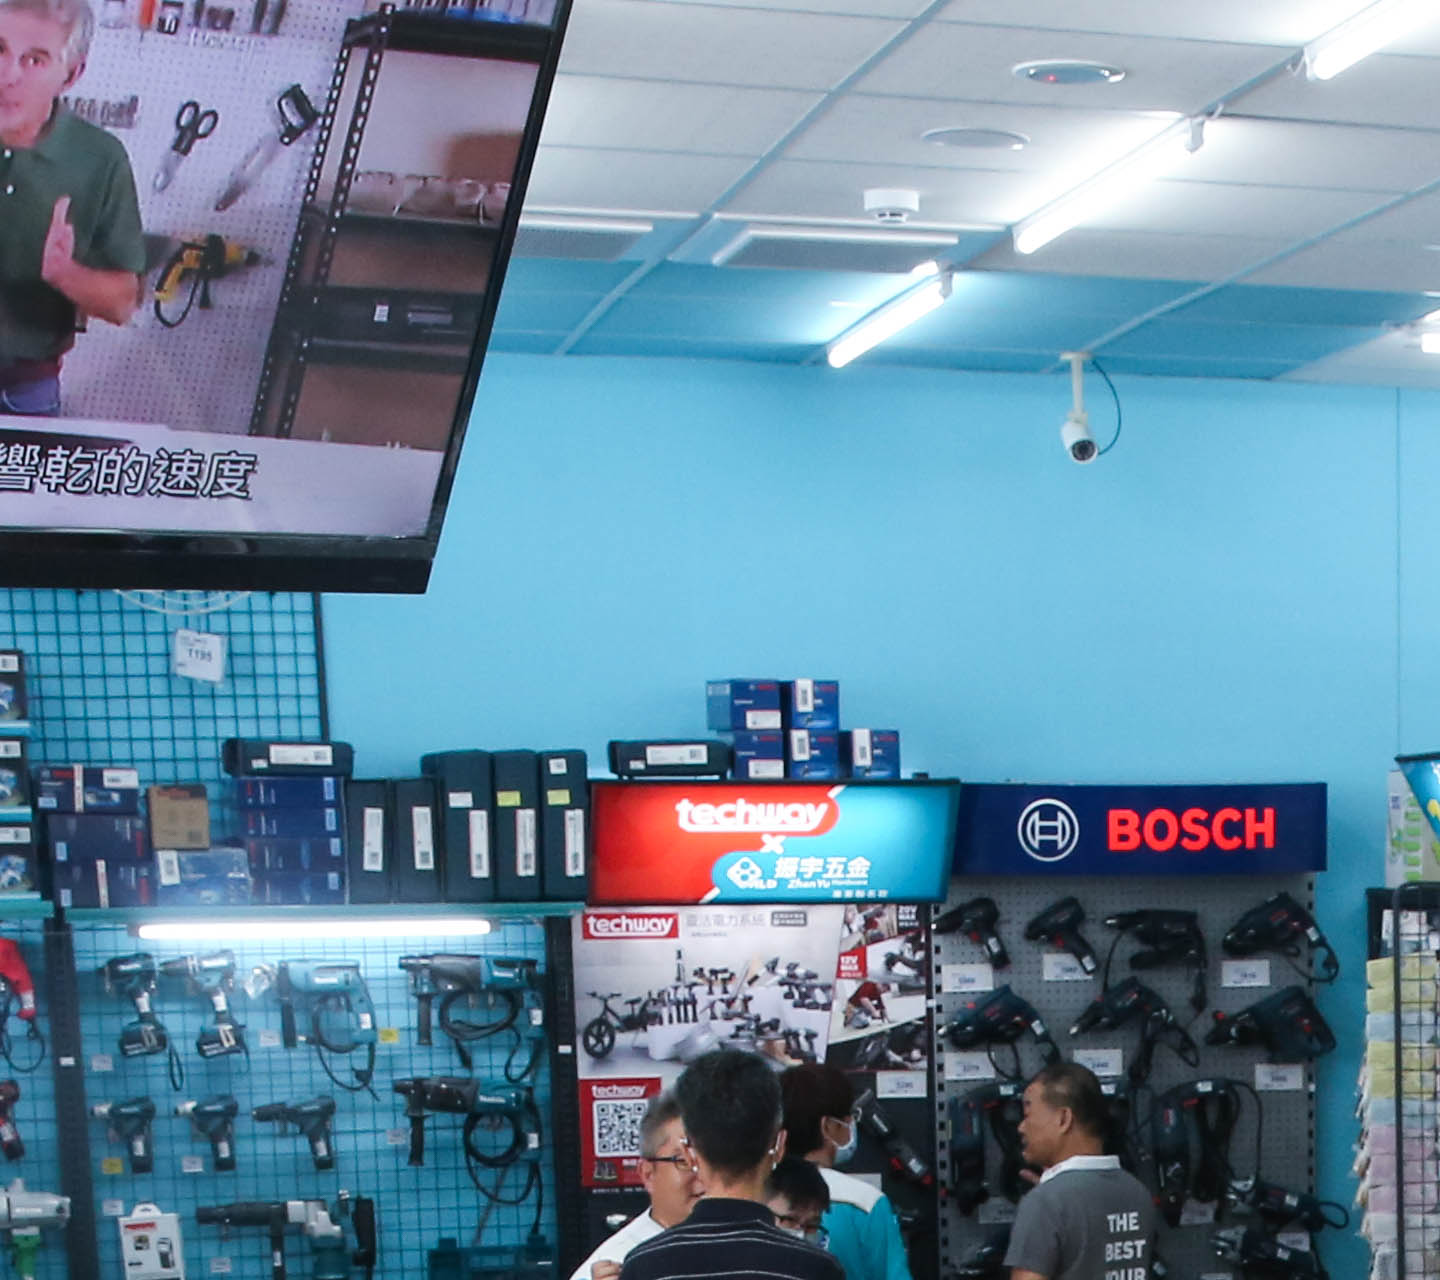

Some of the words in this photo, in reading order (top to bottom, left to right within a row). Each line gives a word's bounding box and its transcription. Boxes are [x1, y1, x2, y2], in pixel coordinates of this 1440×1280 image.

[675, 797, 829, 832] techway
[1107, 807, 1276, 853] BOSCH
[774, 857, 872, 879] 振宇五金
[587, 914, 674, 938] techway
[1106, 1212, 1140, 1233] THE
[1105, 1240, 1147, 1262] BEST
